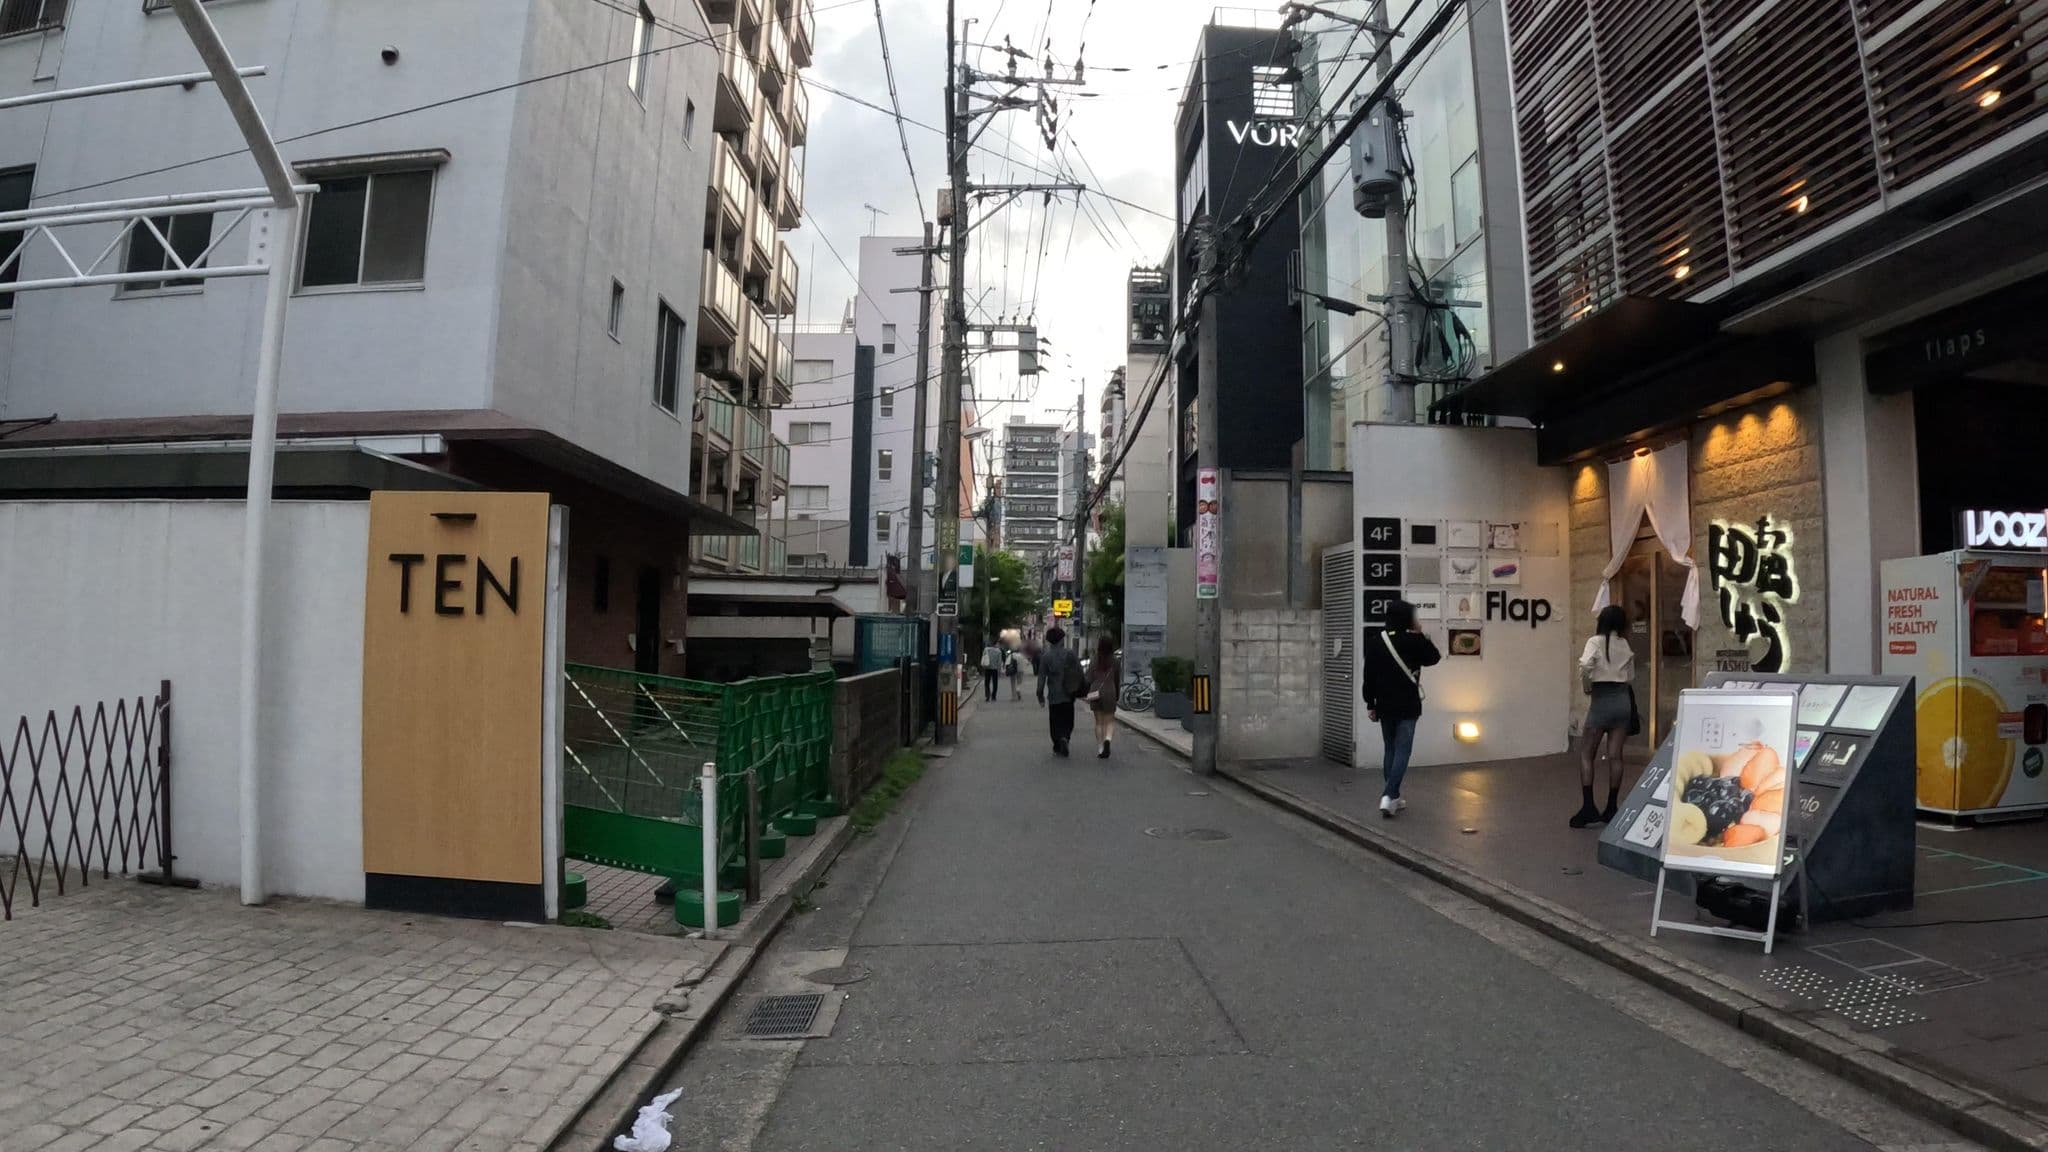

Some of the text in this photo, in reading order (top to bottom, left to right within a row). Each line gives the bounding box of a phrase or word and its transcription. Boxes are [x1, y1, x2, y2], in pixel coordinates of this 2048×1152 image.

[1227, 120, 1305, 147] VOR
[1925, 328, 1985, 360] flaps
[1370, 526, 1393, 541] 4F
[1370, 563, 1393, 578] 3F
[389, 554, 518, 615] TEN
[1888, 587, 1939, 602] NATURAL
[1486, 590, 1551, 629] Flap
[1888, 605, 1922, 619] FRESH
[1888, 620, 1938, 635] HEALTHY
[1640, 766, 1664, 788] 2F
